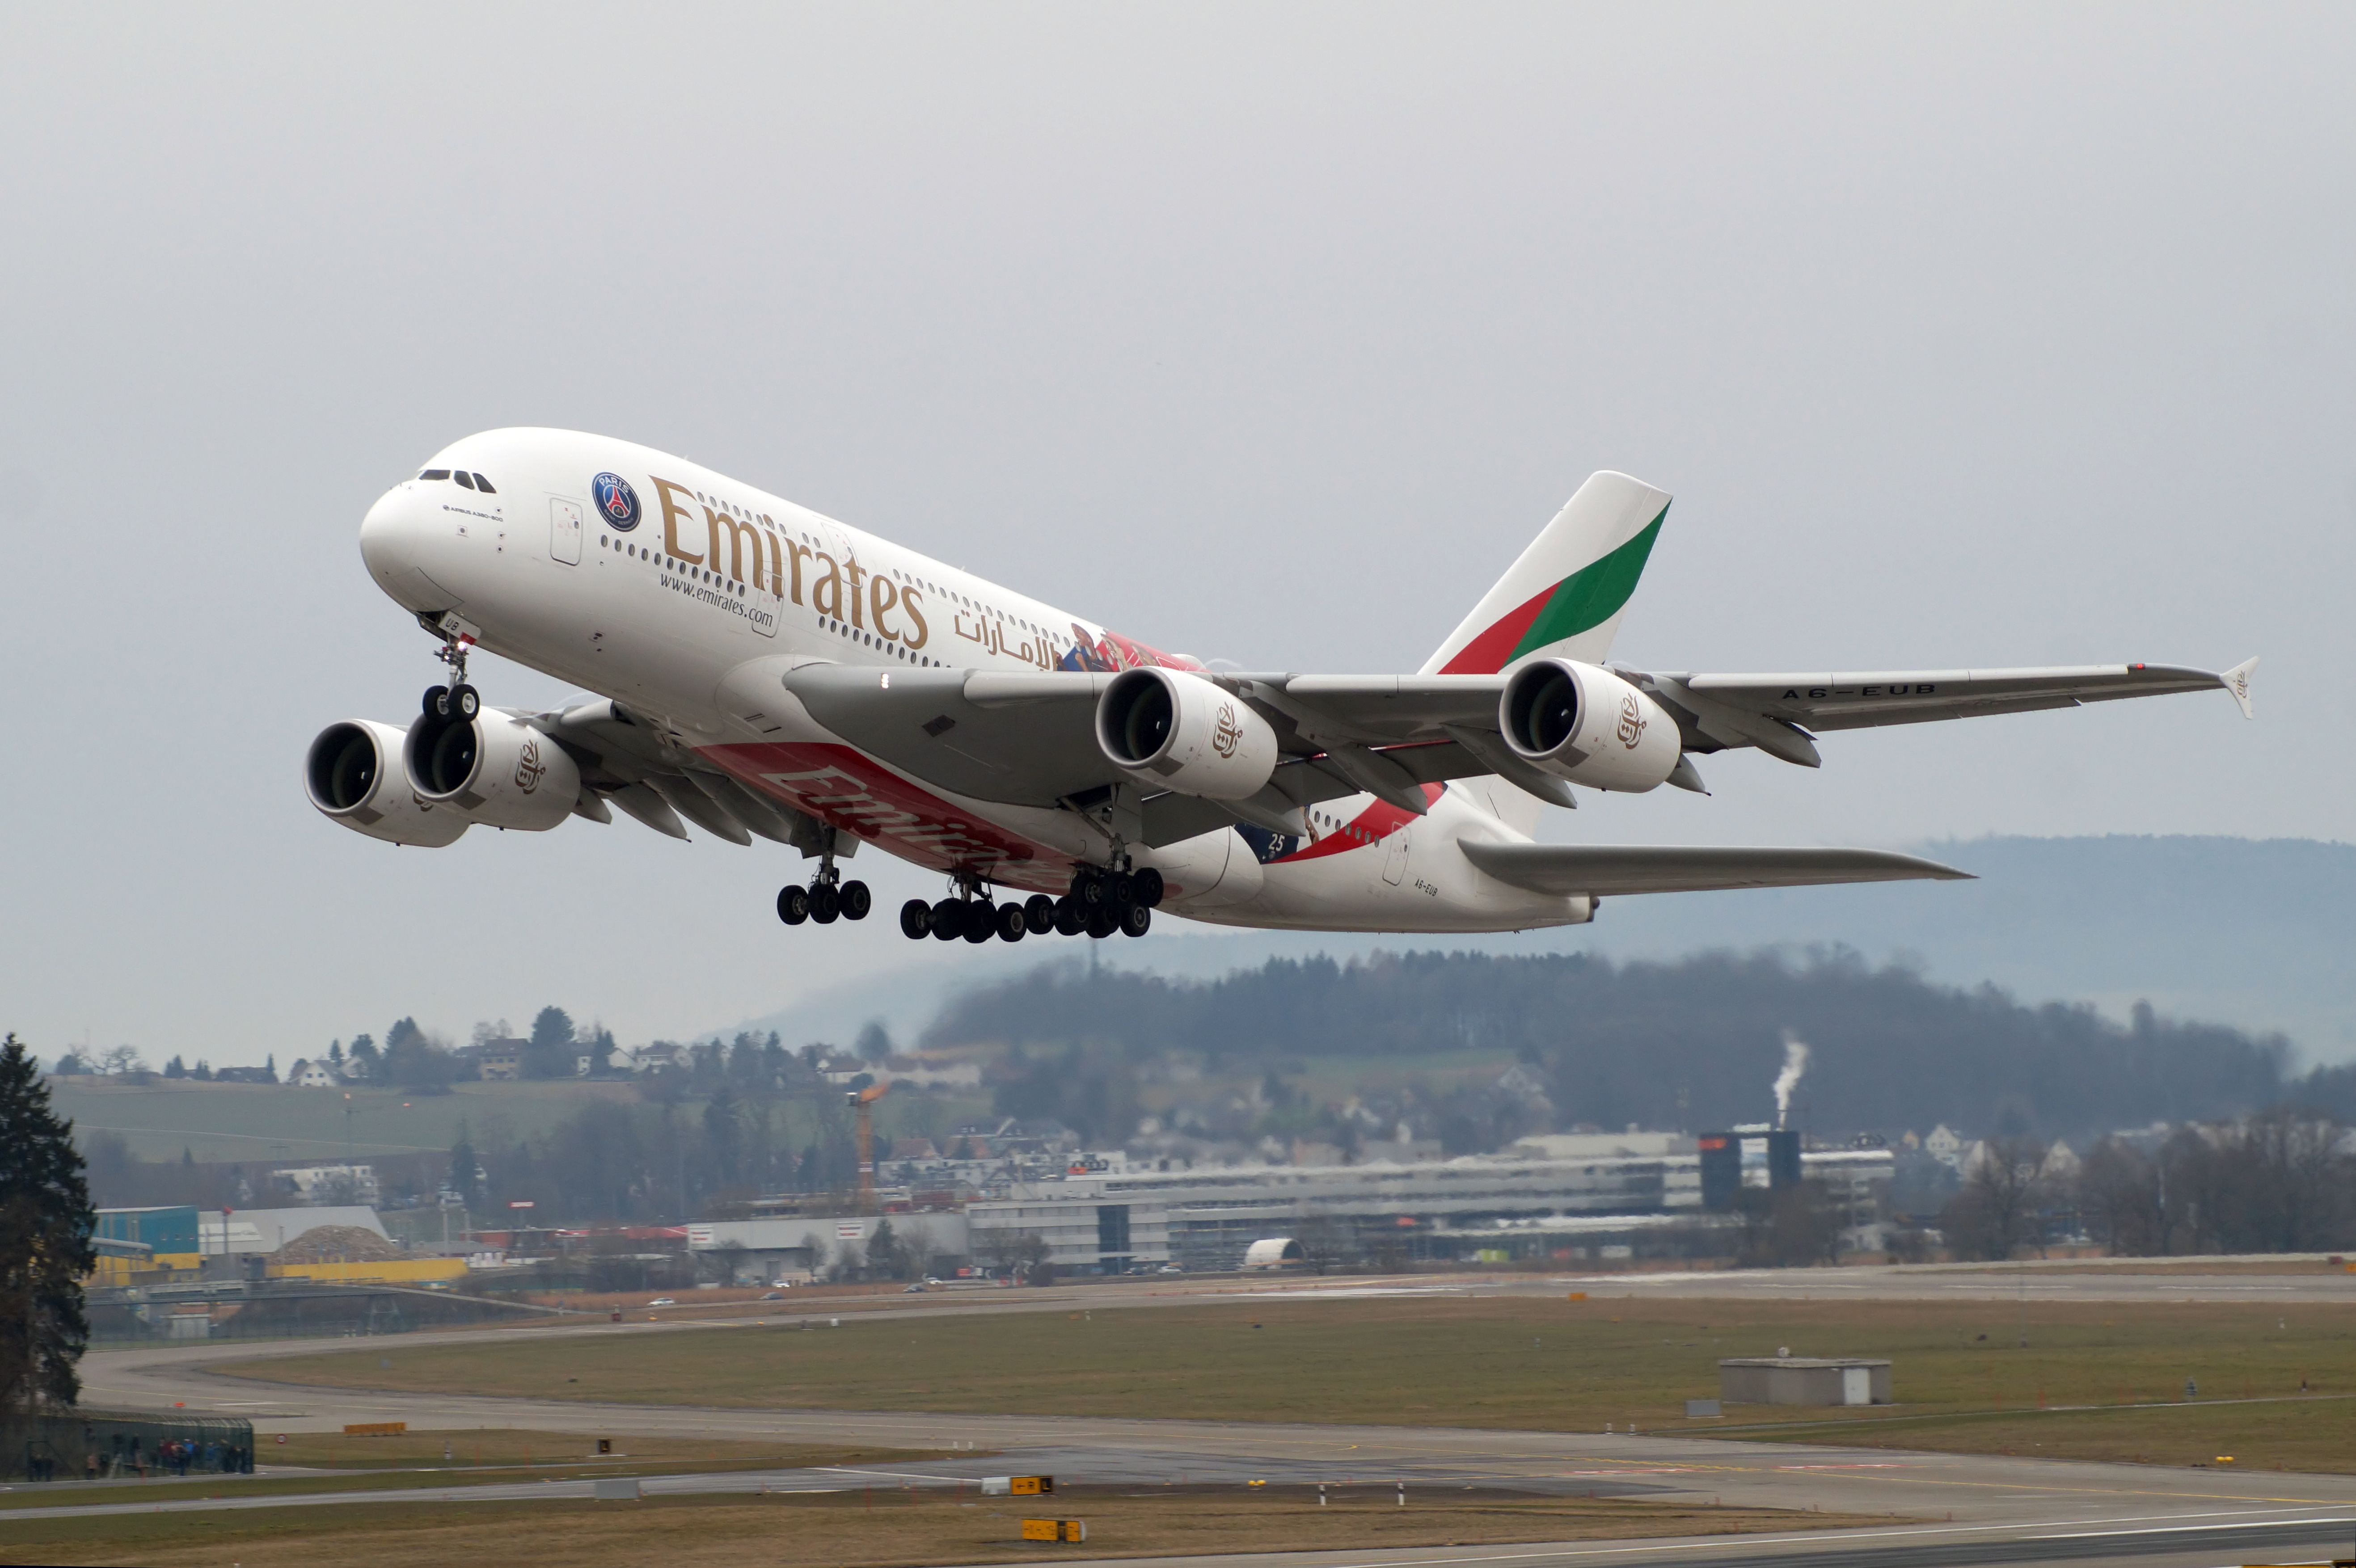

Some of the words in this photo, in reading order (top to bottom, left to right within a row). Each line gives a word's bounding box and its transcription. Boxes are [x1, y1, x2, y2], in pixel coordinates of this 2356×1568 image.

[599, 476, 629, 493] PARIS
[473, 511, 503, 522] A380-800
[648, 475, 928, 650] Emirates
[661, 573, 773, 628] www.emirates.com
[446, 618, 459, 630] UB
[1782, 684, 1935, 699] A6-EUB
[1268, 833, 1285, 851] 25
[1414, 878, 1438, 897] A6-EUB
